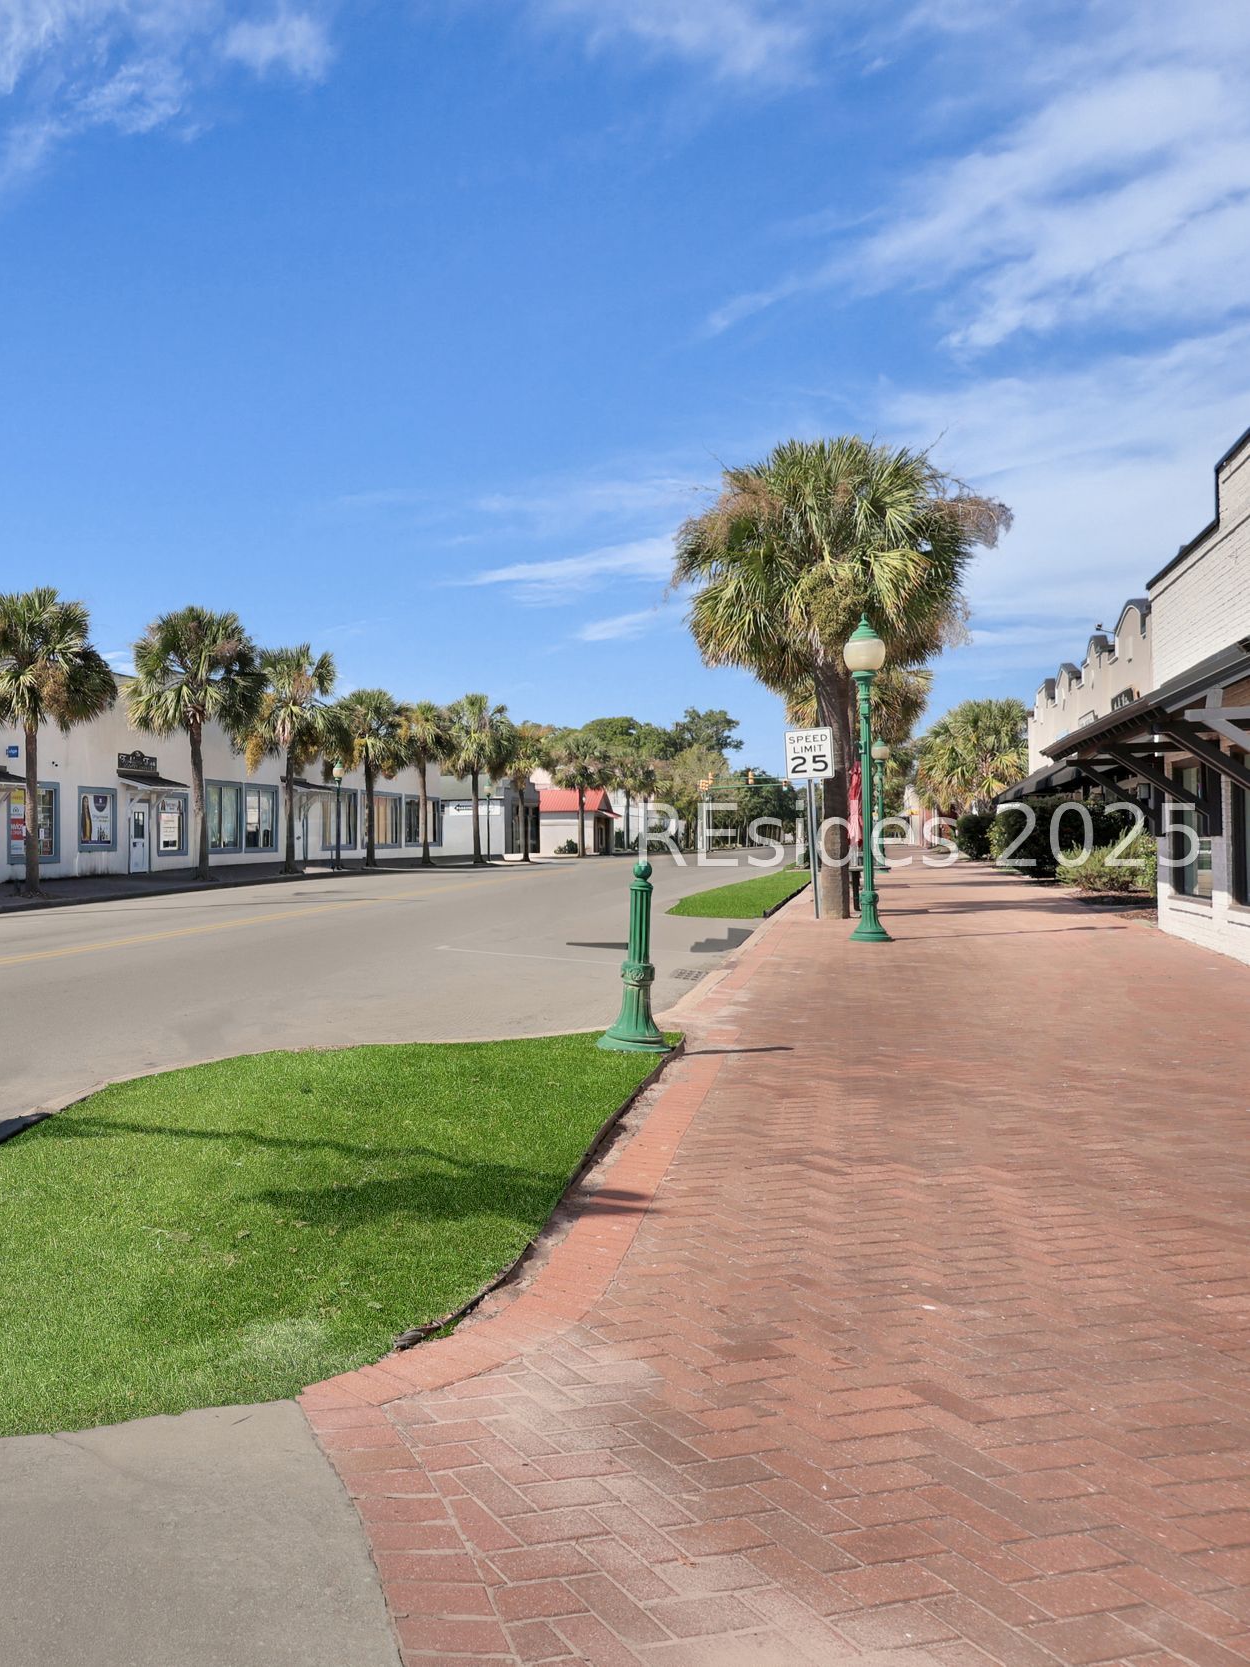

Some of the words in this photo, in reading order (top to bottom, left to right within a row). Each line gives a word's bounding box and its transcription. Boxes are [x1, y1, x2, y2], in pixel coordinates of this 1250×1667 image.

[788, 734, 828, 745] SPEED
[793, 744, 823, 754] LIMIT
[791, 754, 829, 774] 25
